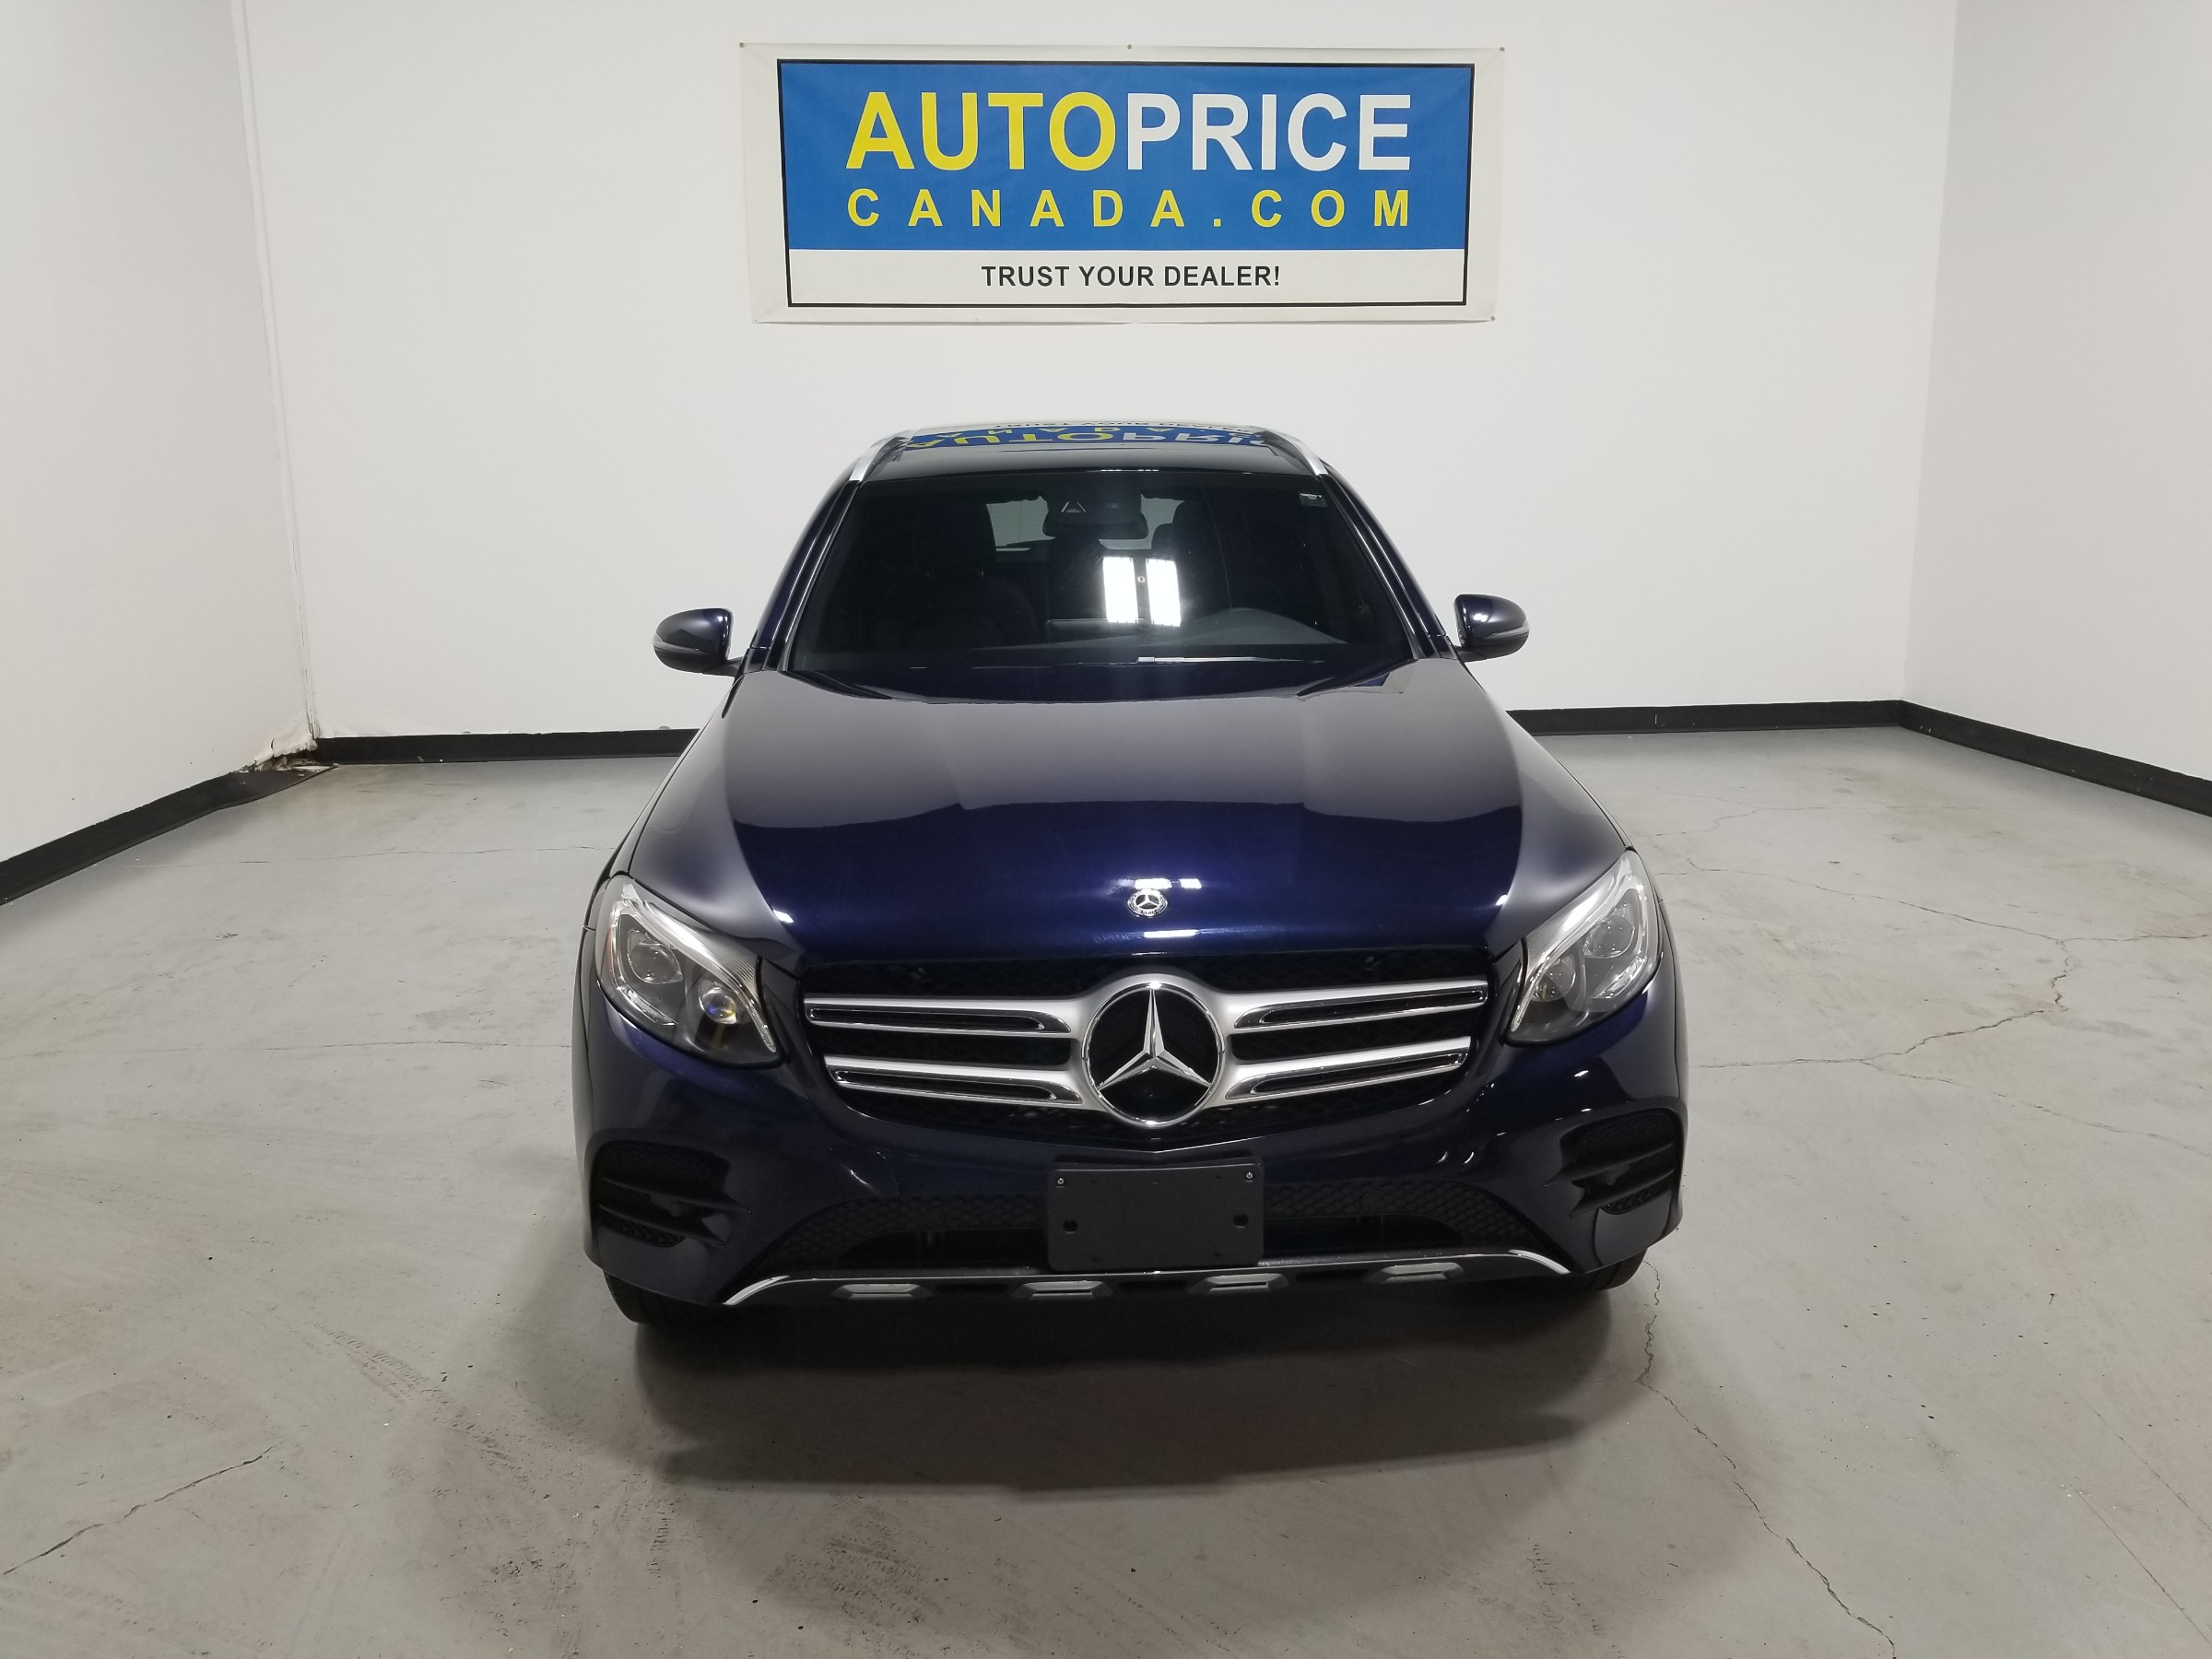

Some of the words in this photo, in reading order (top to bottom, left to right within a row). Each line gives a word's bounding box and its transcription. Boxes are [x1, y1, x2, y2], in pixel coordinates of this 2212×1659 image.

[845, 91, 1412, 172] AUTOPRICE
[981, 265, 1070, 287] TRUST
[1077, 265, 1156, 287] YOUR
[1164, 265, 1280, 287] DEALER!
